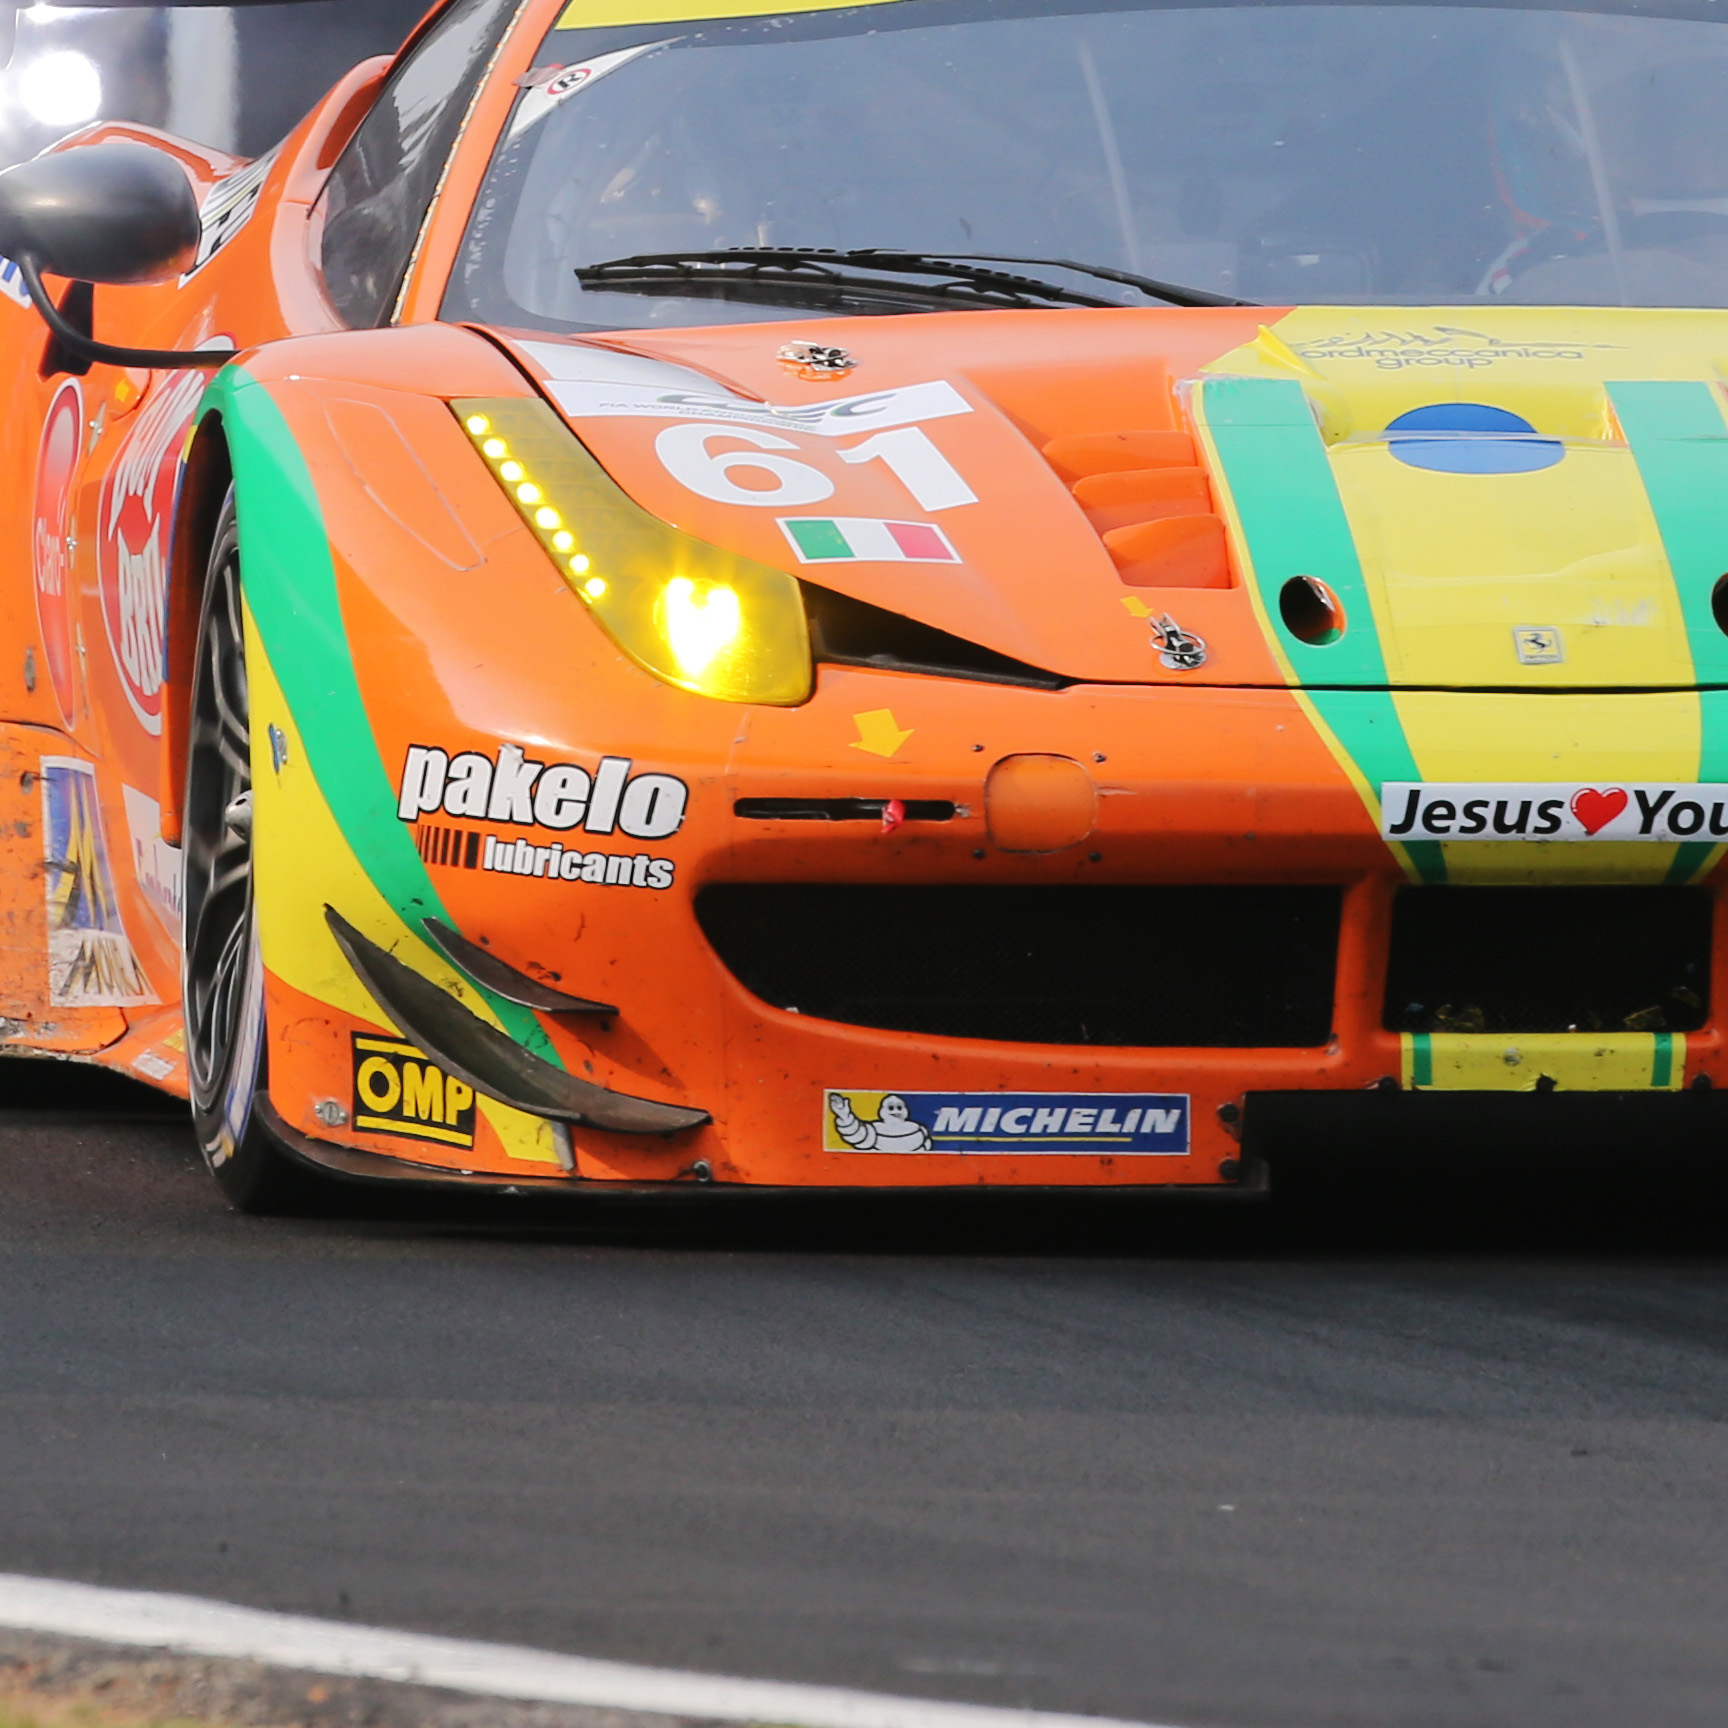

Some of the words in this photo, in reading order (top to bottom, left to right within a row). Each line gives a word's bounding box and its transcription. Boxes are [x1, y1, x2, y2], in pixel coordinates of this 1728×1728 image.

[1299, 345, 1585, 360] ordmeccanica
[1375, 355, 1493, 370] group
[655, 422, 980, 512] 61
[397, 743, 689, 841] pakelo
[1388, 788, 1565, 836] Jesus
[482, 833, 675, 890] lubricants
[357, 1056, 474, 1126] OMP
[932, 1106, 1183, 1134] MICHELIN
